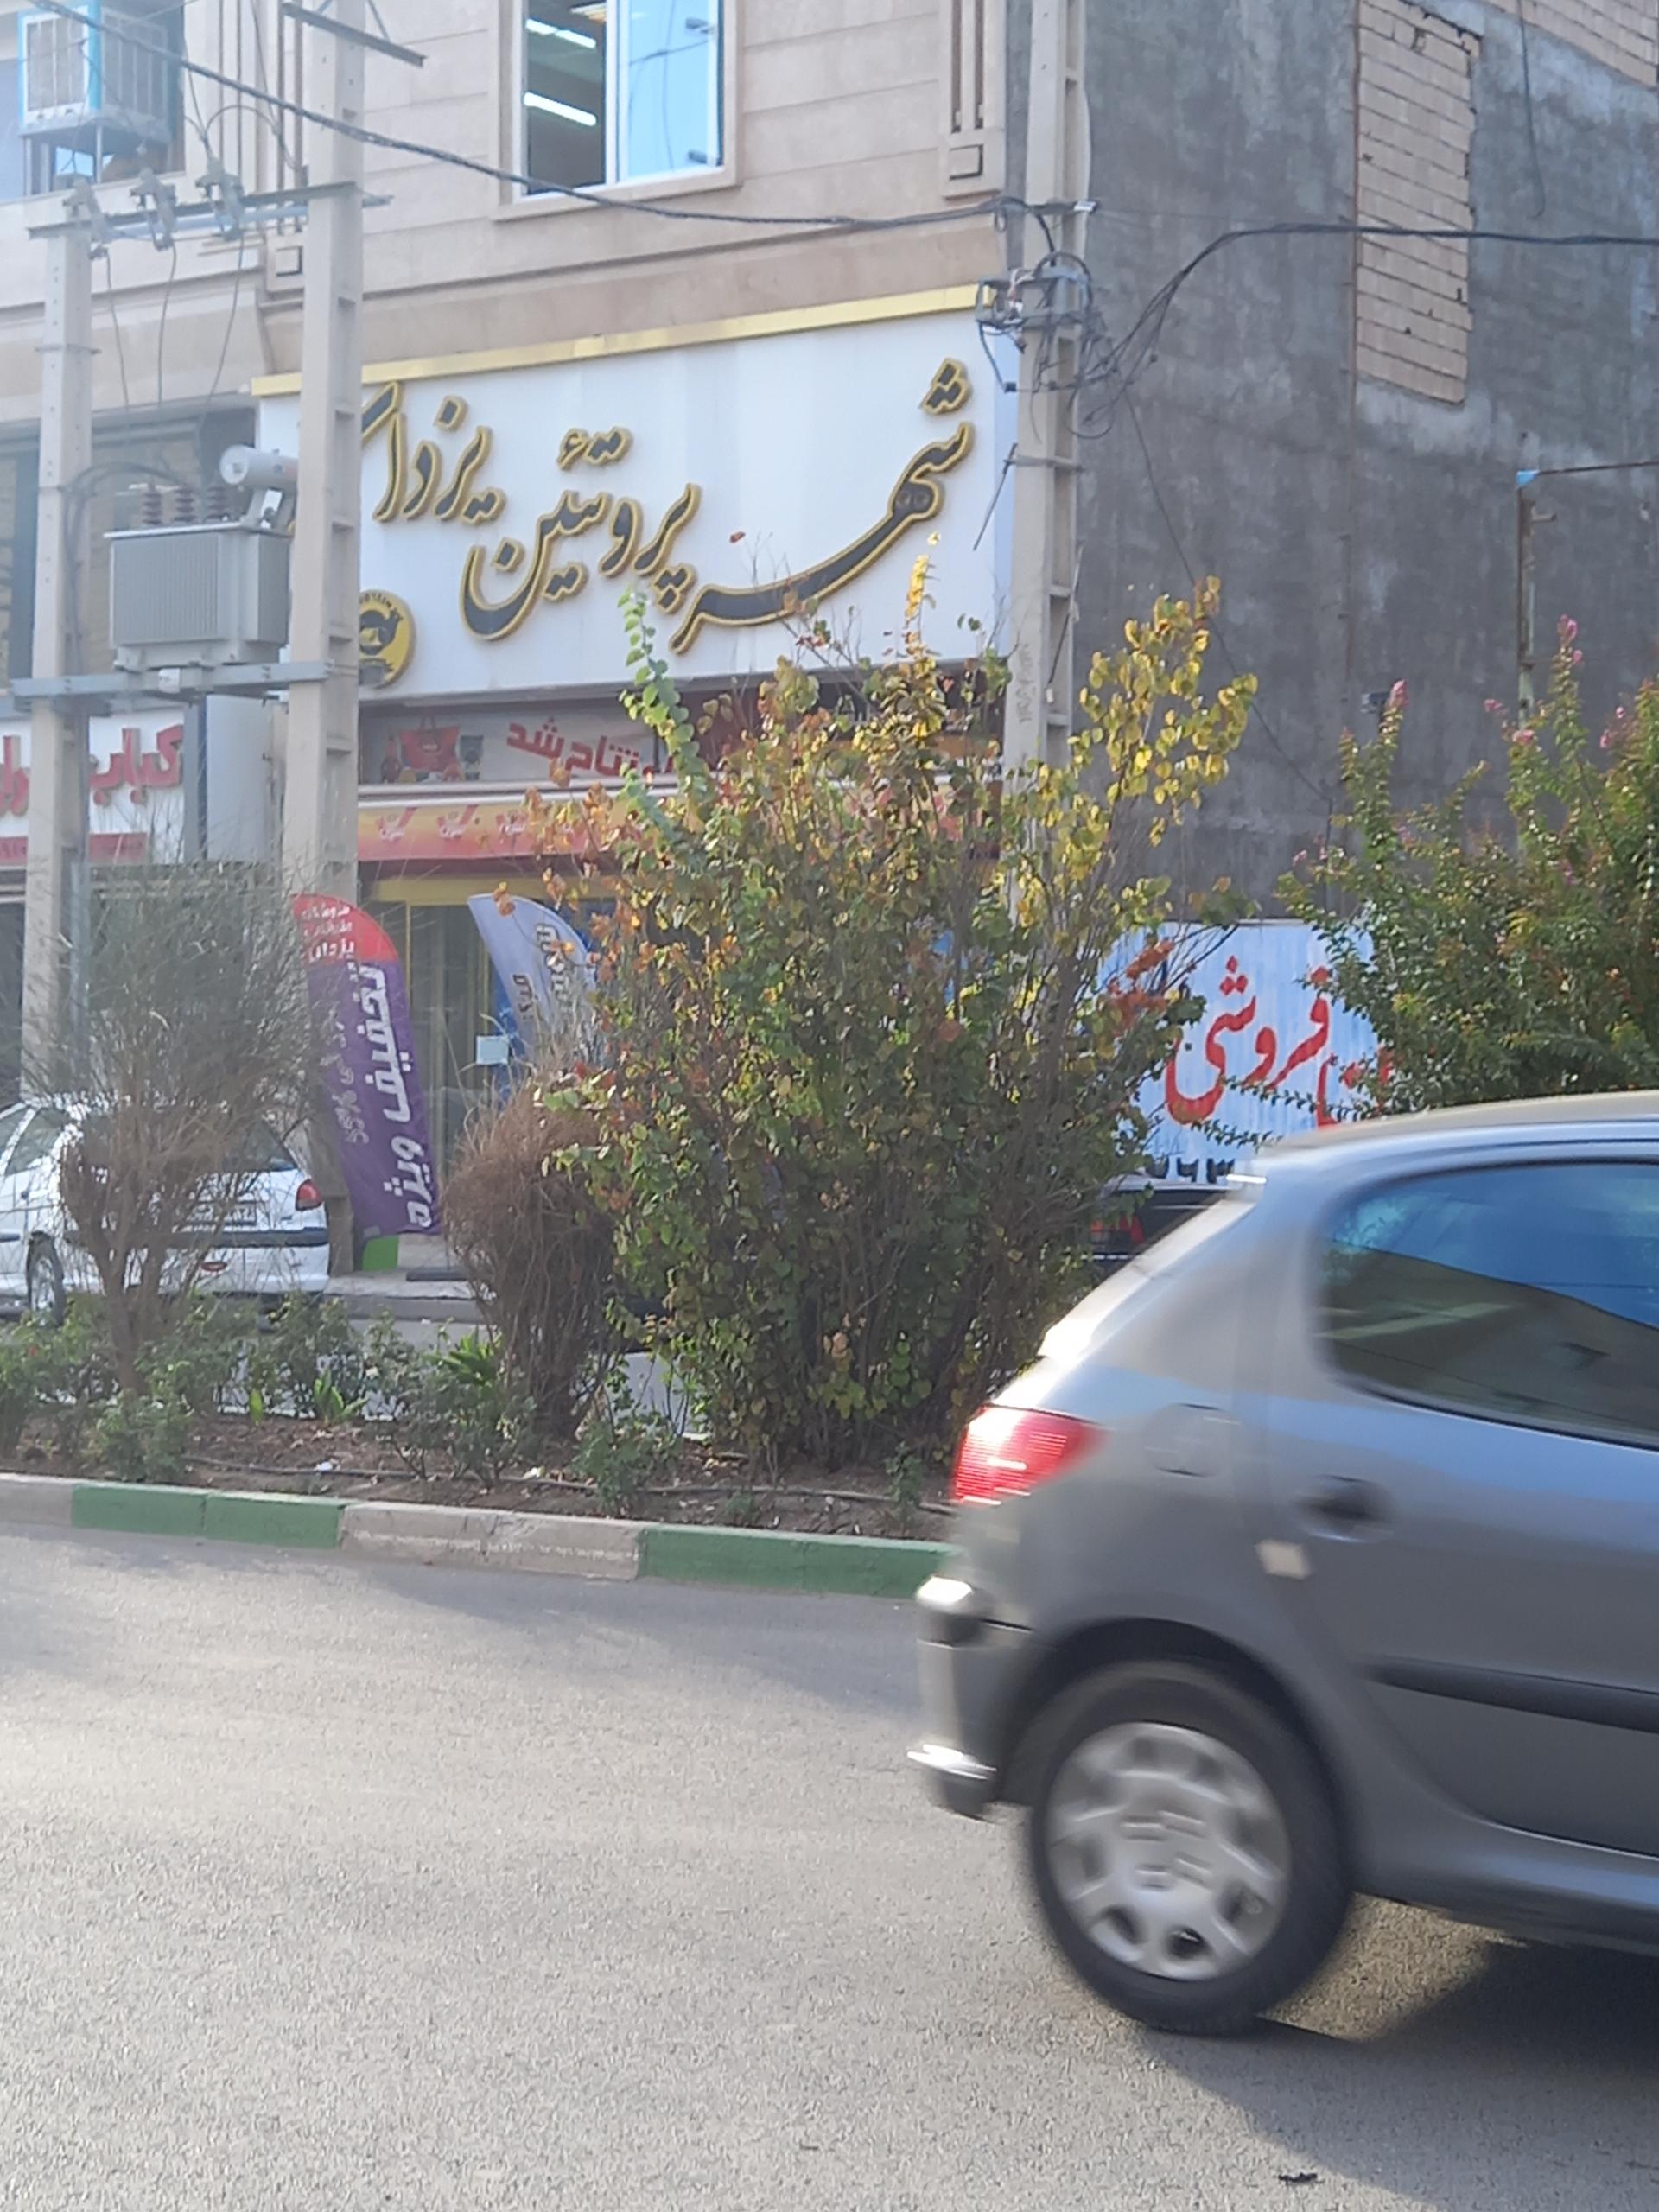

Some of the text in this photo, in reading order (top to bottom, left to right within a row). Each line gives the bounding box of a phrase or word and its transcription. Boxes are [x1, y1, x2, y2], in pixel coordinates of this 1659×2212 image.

[359, 357, 976, 655] شهر پروتئین یزدا
[506, 715, 565, 760] شد
[346, 960, 433, 1229] تخفیف ویژه
[1164, 955, 1332, 1124] فروشی
